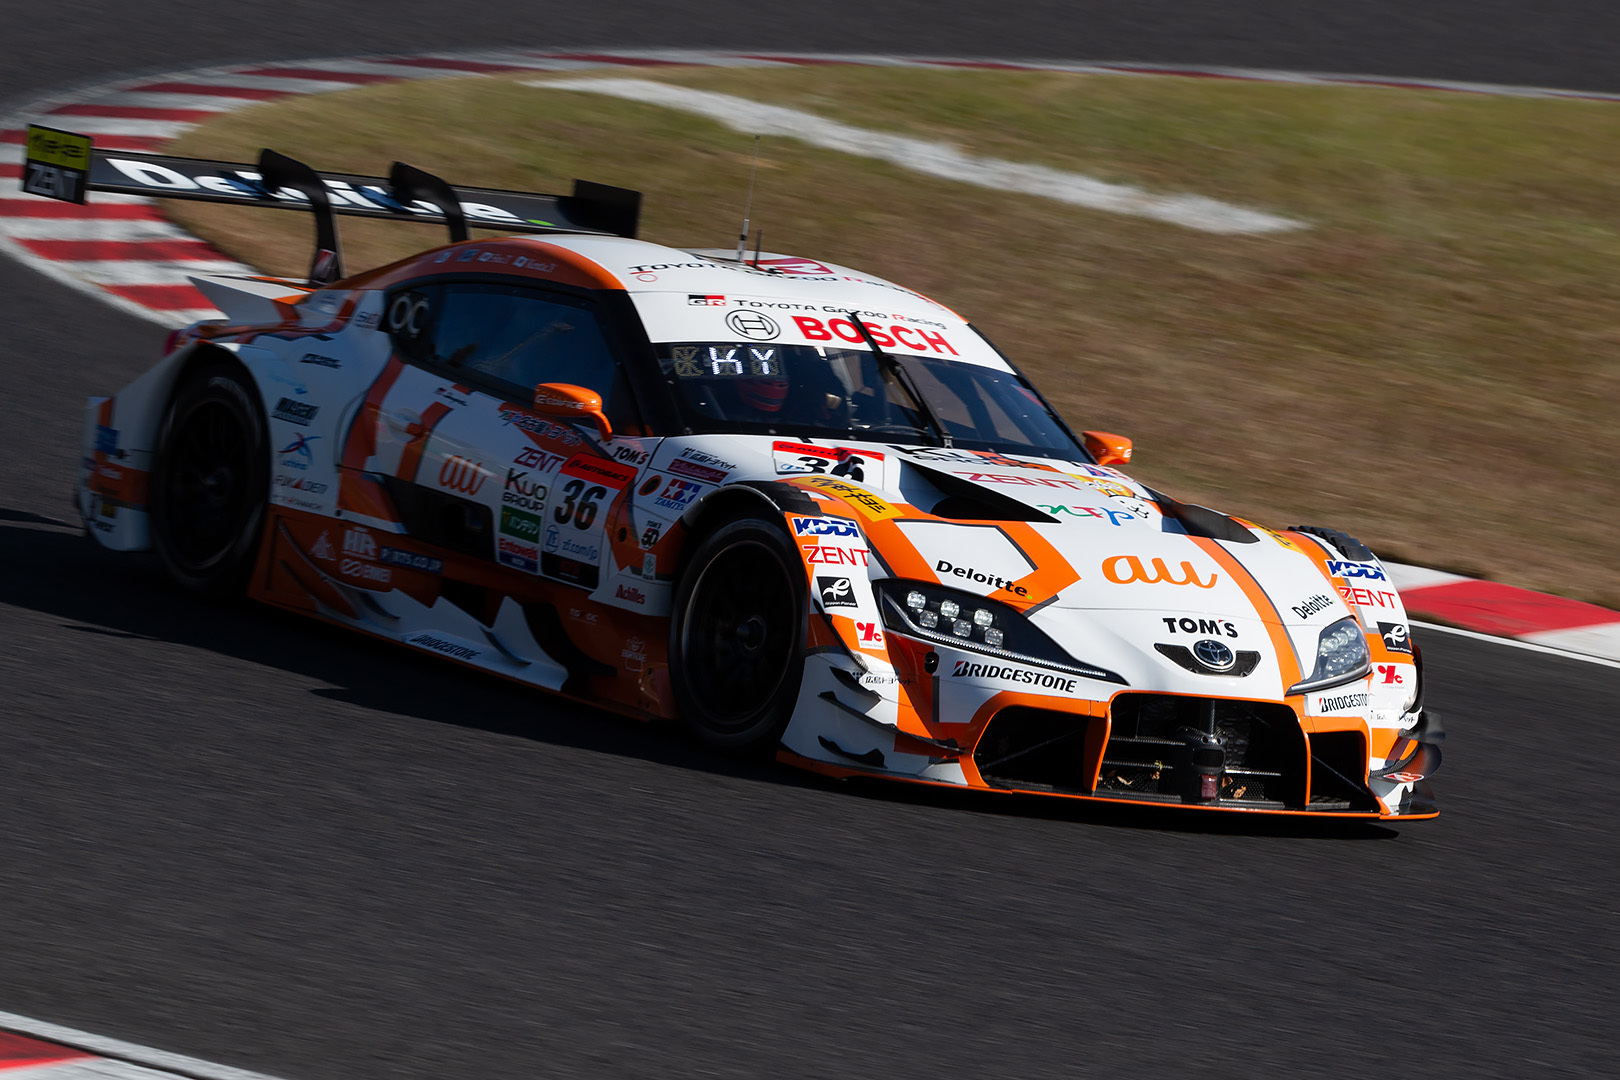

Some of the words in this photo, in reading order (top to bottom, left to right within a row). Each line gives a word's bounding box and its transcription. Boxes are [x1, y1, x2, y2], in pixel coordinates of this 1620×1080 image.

[733, 299, 817, 312] TOYOTA
[892, 313, 947, 330] Racing
[791, 315, 961, 356] BOSCH
[513, 446, 565, 474] ZENT
[613, 446, 650, 465] TOM'S
[438, 454, 488, 496] au
[580, 464, 631, 482] AUTOBACS
[796, 455, 865, 483] 36
[952, 471, 1083, 491] ZENT
[554, 479, 607, 531] 36
[793, 518, 860, 538] KDDI
[803, 545, 872, 568] ZENT
[1101, 555, 1218, 589] au
[1326, 560, 1387, 582] KDDI
[615, 584, 646, 605] Achilles
[1338, 586, 1395, 609] ZENT
[1162, 617, 1239, 639] TOM'S
[952, 660, 1078, 694] BRIDGESTONE
